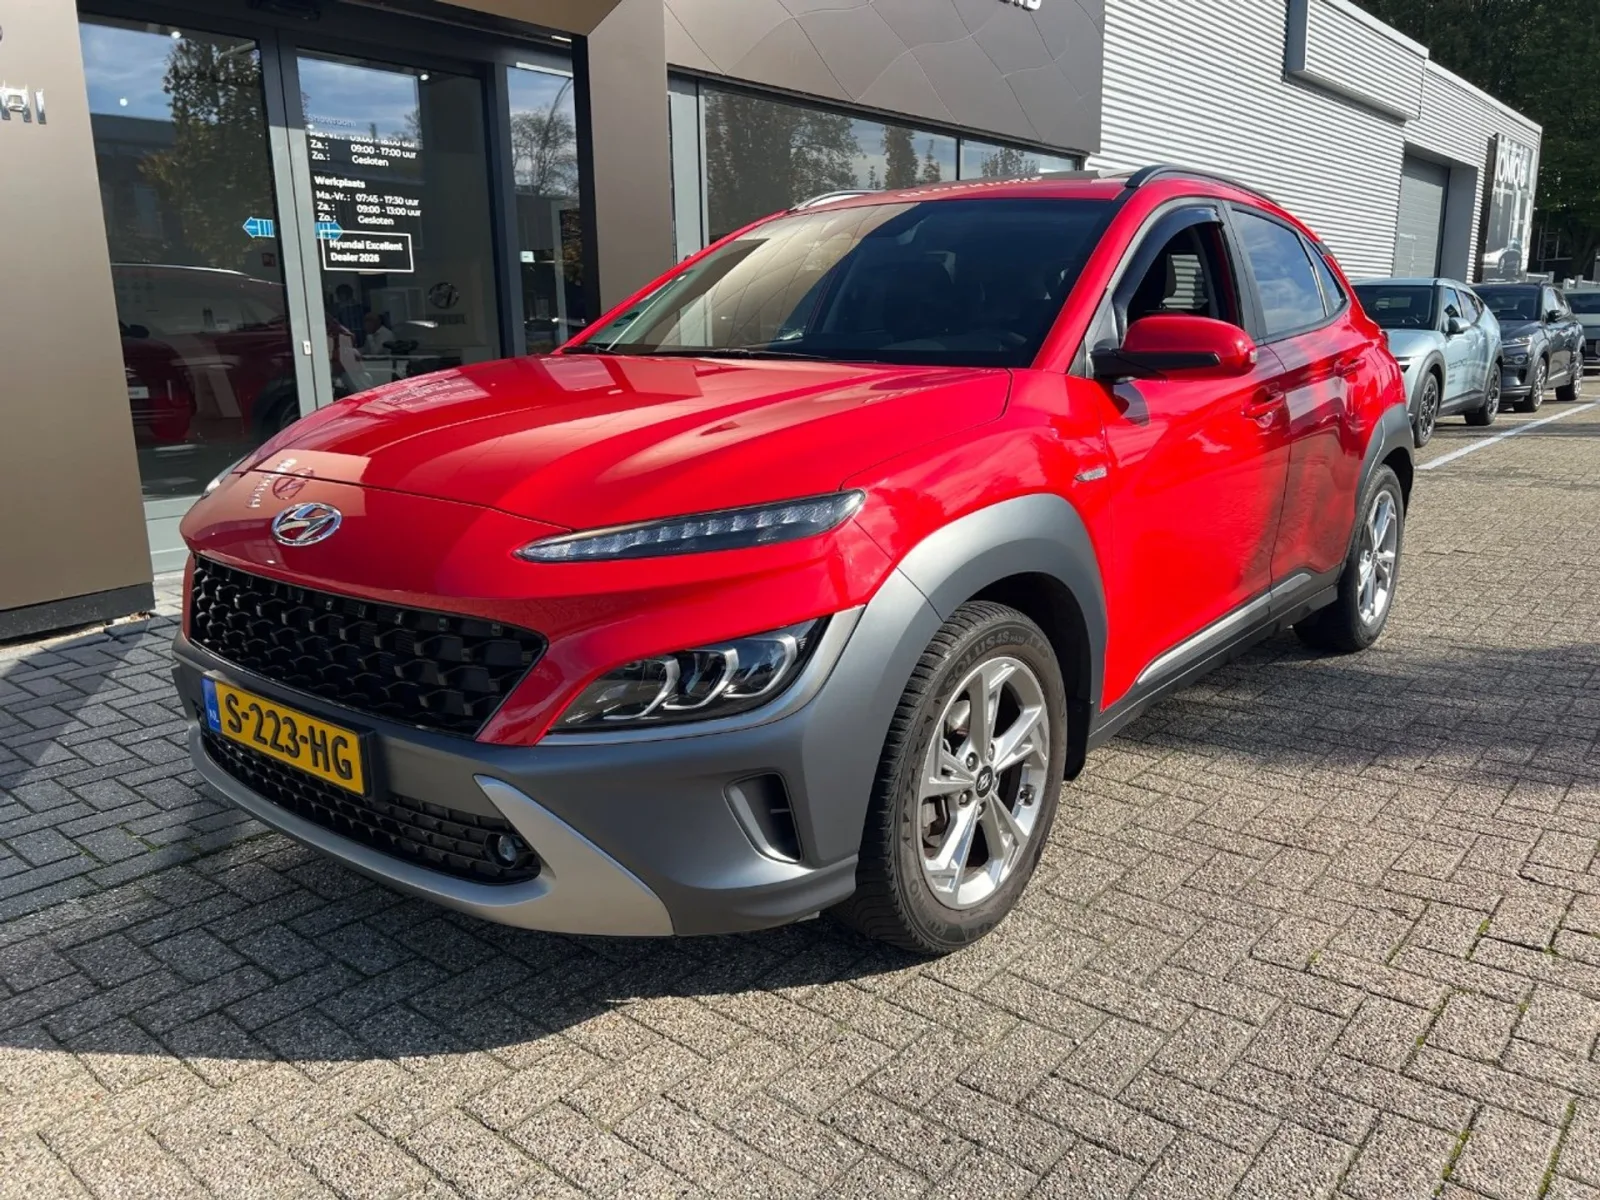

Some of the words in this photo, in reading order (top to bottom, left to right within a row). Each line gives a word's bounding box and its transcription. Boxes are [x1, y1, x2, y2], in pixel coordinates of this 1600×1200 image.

[351, 144, 374, 154] 09:00
[381, 147, 401, 157] 17:00
[402, 151, 417, 159] uur
[352, 155, 389, 167] Gesloten
[314, 176, 366, 188] Werkplaats
[355, 193, 379, 204] 07:45
[384, 195, 404, 205] 17:30
[356, 204, 380, 214] 09:00
[386, 206, 406, 216] 13:00
[407, 209, 421, 217] uur
[357, 215, 394, 226] Gesloten
[329, 240, 365, 250] Hyundai
[365, 241, 403, 251] Excellent
[330, 252, 358, 262] Dealer
[359, 253, 380, 262] 2026
[208, 709, 220, 724] NL
[225, 693, 353, 780] S-223-HG
